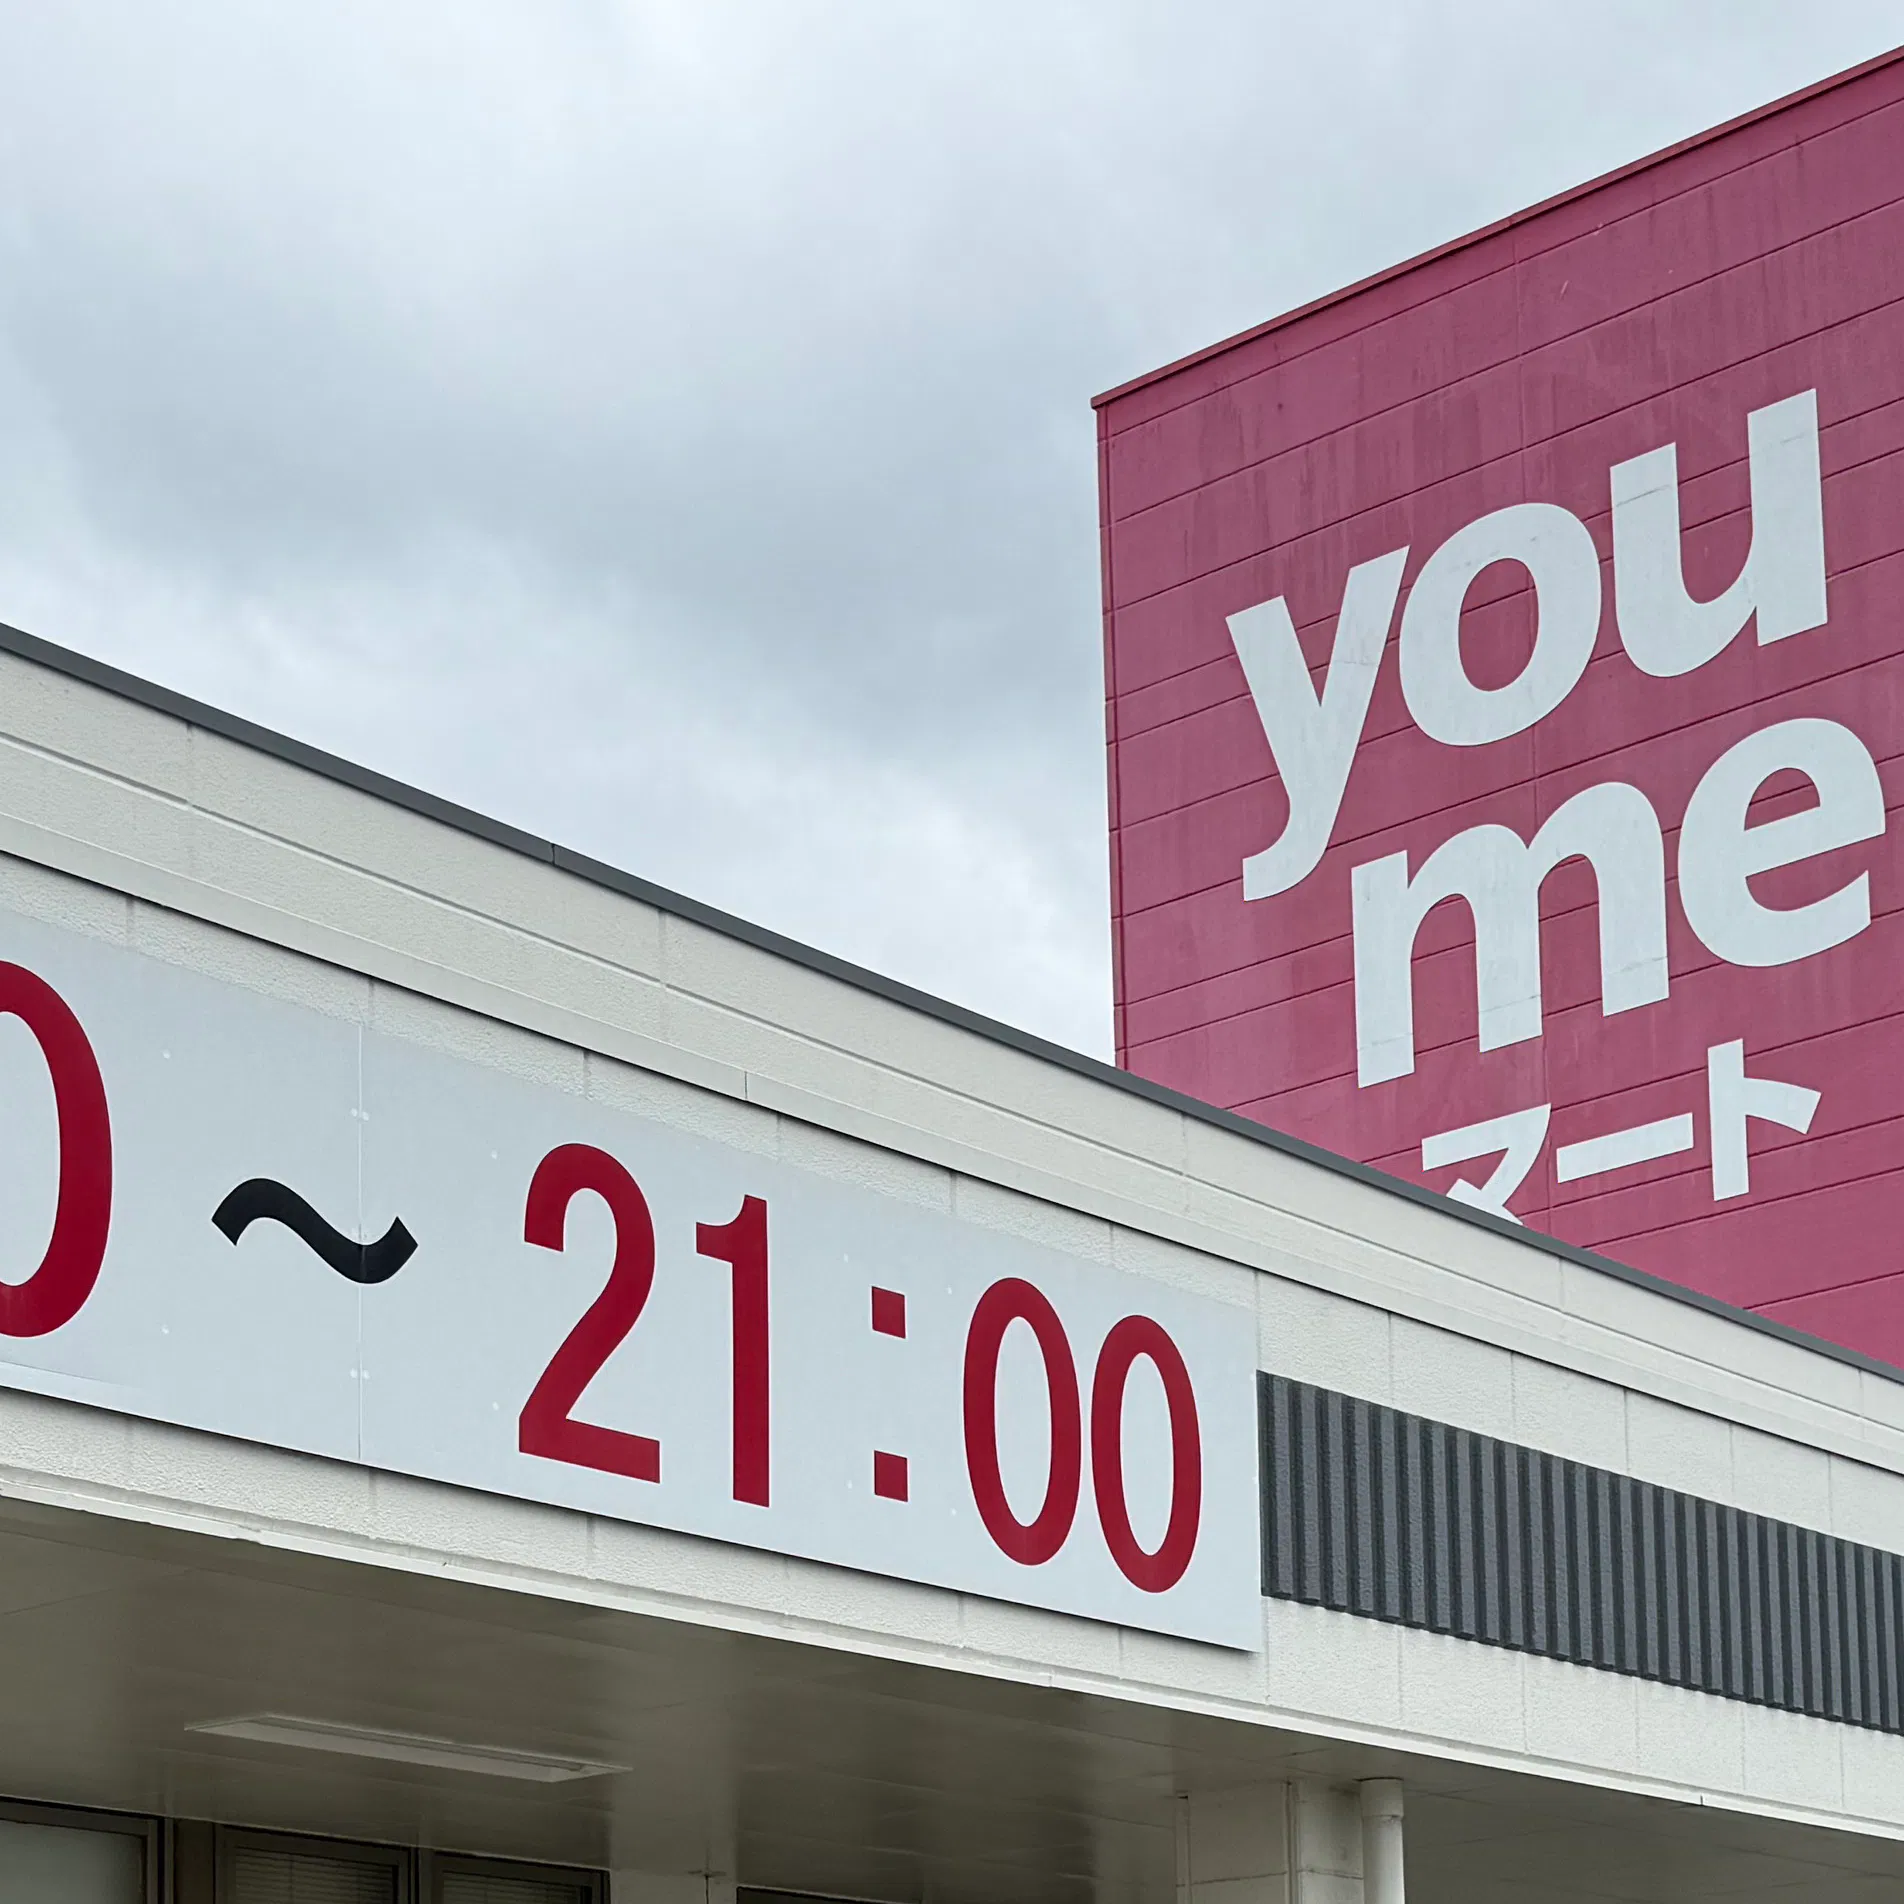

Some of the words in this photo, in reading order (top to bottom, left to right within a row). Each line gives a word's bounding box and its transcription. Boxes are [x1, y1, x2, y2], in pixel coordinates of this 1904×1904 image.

[1225, 388, 1828, 901] you
[1351, 717, 1886, 1089] me
[1421, 1038, 1823, 1226] マート
